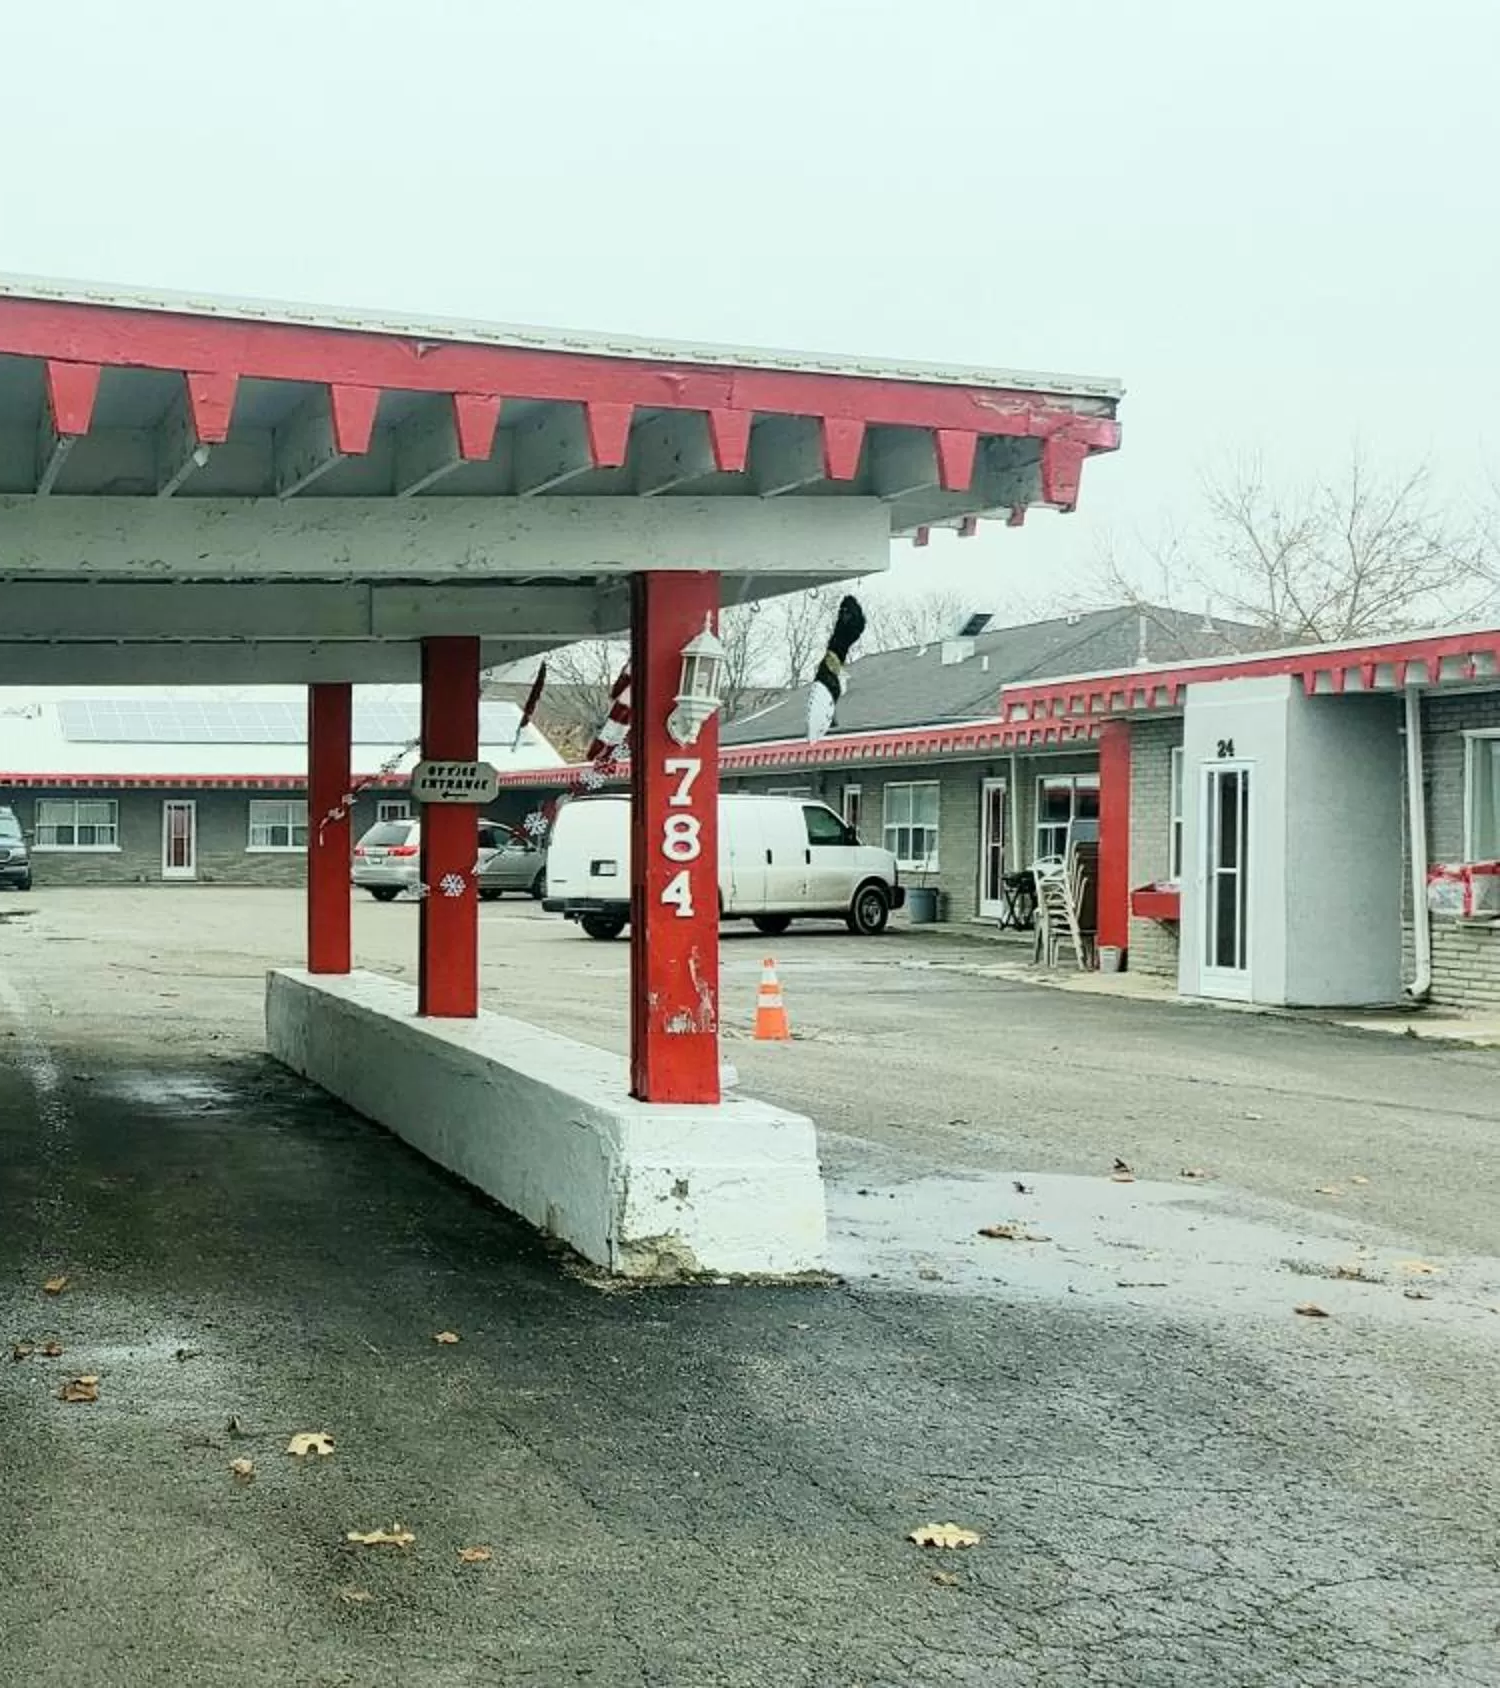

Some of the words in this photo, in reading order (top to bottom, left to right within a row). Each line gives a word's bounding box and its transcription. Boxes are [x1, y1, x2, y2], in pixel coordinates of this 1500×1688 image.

[1216, 738, 1235, 758] 24
[427, 766, 477, 777] OFFICE
[421, 779, 489, 791] ENTRANCE
[661, 758, 702, 917] 784
